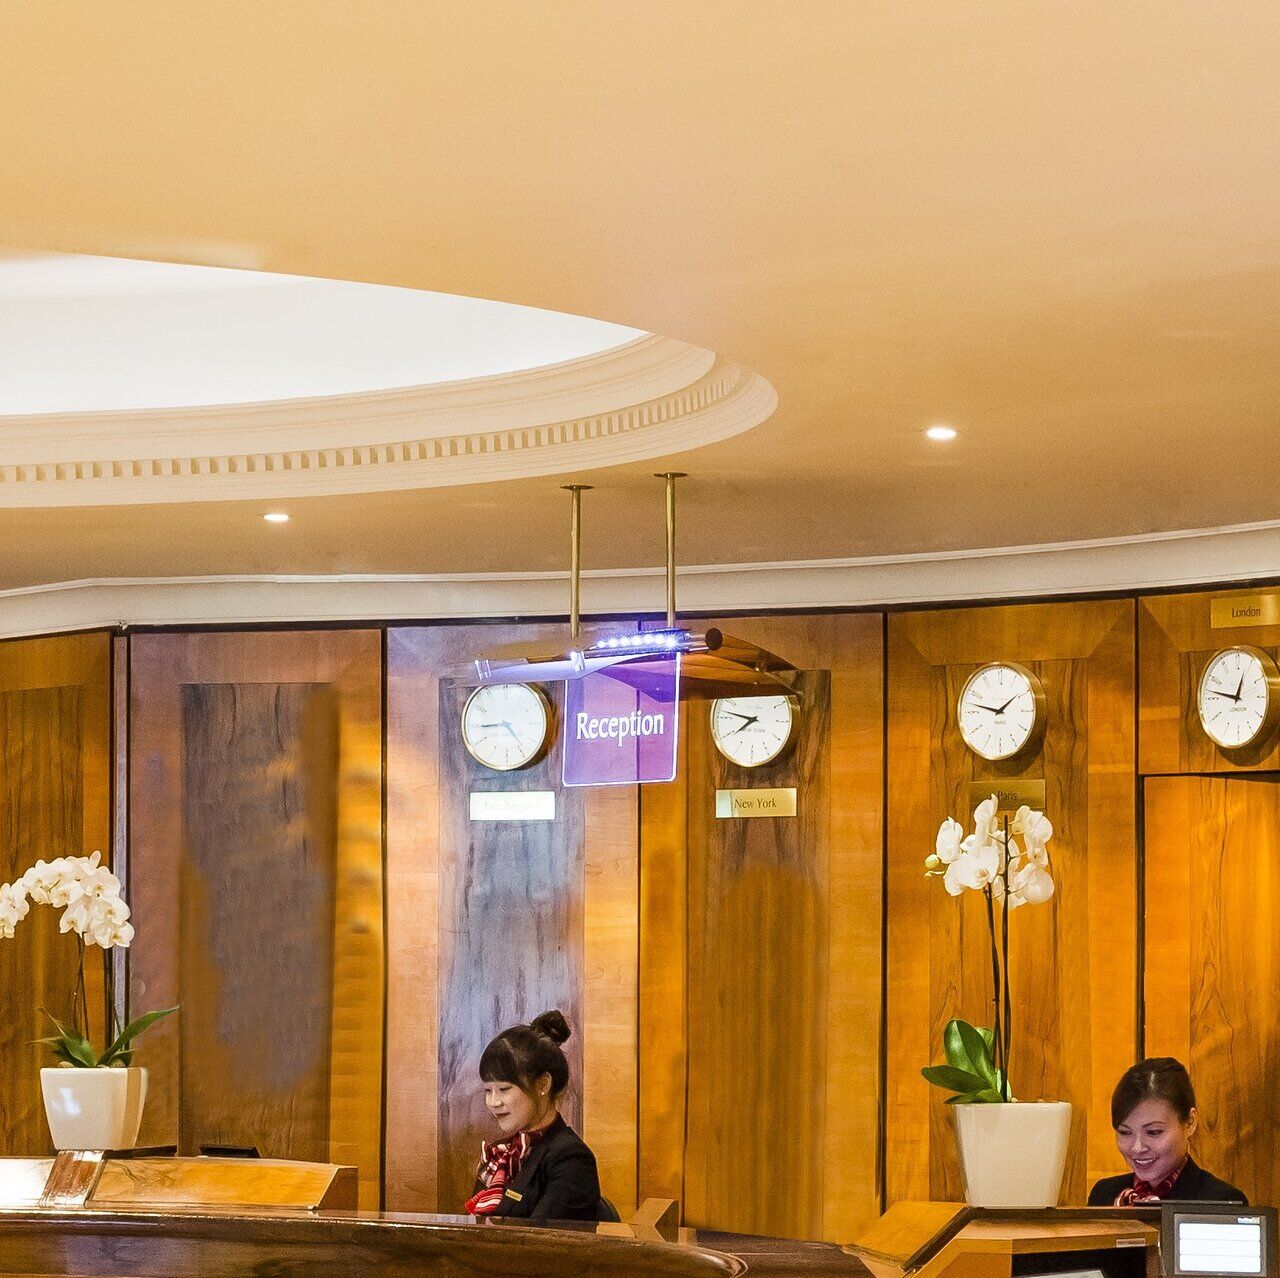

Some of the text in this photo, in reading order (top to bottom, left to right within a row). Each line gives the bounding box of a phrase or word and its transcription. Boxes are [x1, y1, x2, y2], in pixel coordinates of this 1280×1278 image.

[1231, 607, 1261, 618] London
[576, 709, 665, 747] Reception
[997, 790, 1018, 801] Paris
[734, 798, 777, 809] New York
